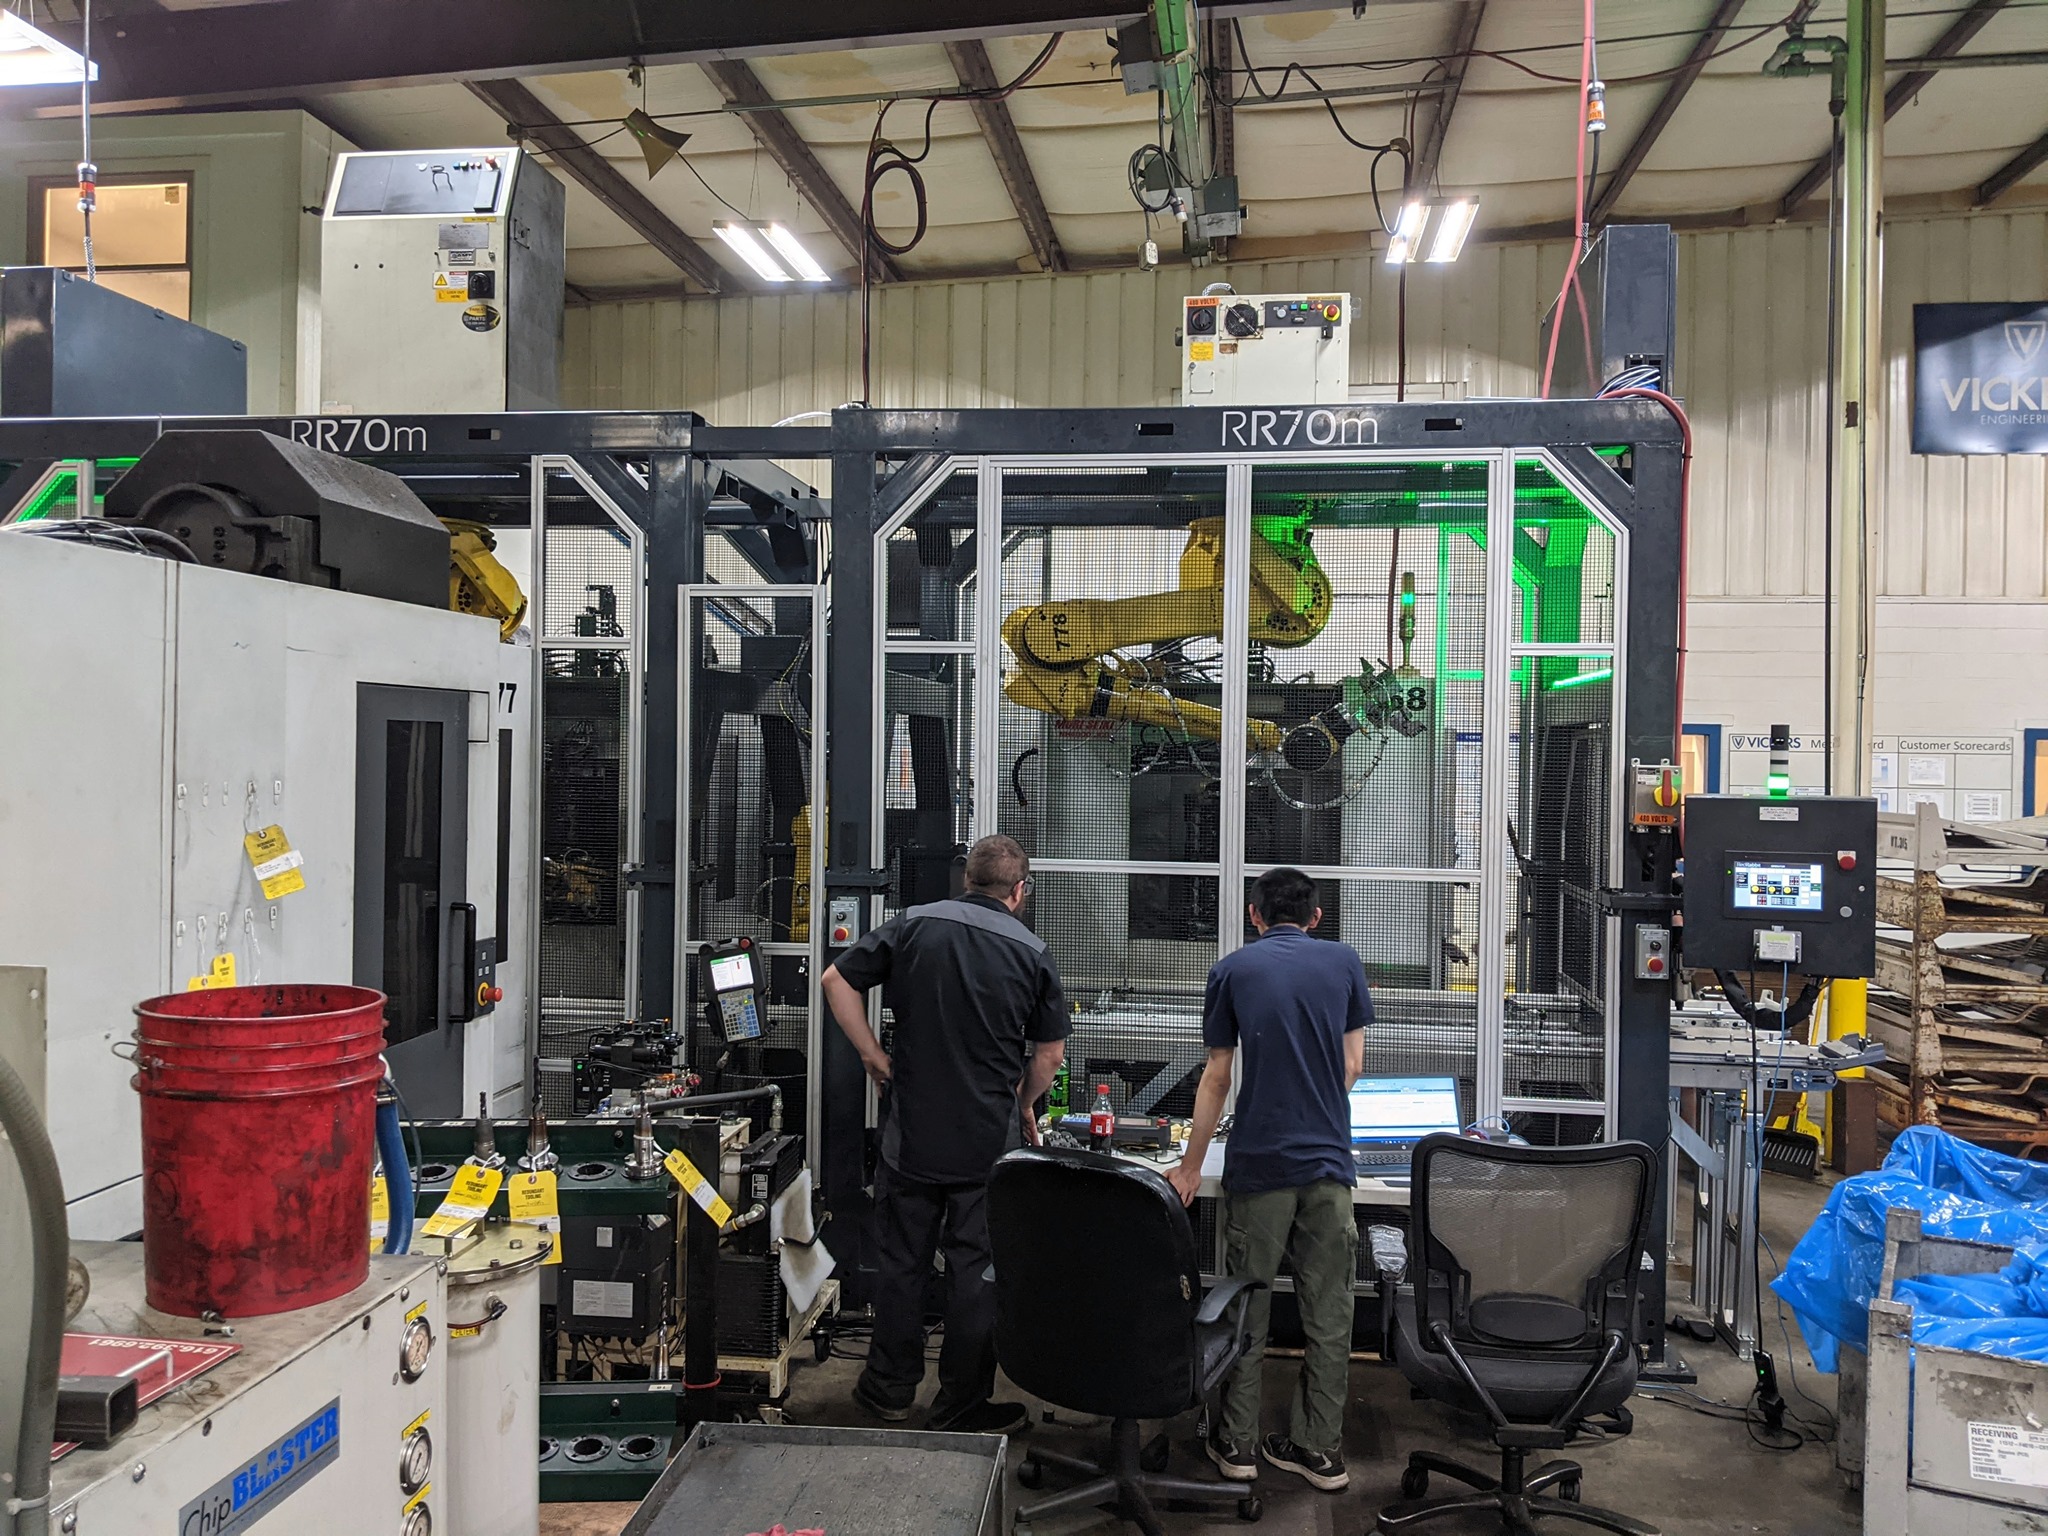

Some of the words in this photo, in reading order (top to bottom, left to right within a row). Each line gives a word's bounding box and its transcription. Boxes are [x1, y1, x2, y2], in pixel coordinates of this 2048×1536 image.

[1980, 414, 2048, 425] ENGINEERI
[1221, 409, 1378, 447] RR70m
[291, 418, 427, 452] RR70m
[1052, 613, 1071, 652] 778
[1747, 736, 1801, 749] VICRS
[1899, 740, 1951, 750] Customer
[1953, 741, 2011, 751] Scorecards
[1651, 815, 1668, 823] VOLTS
[88, 1338, 219, 1355] 616.392.6961
[1971, 1427, 2018, 1440] RECEIVING
